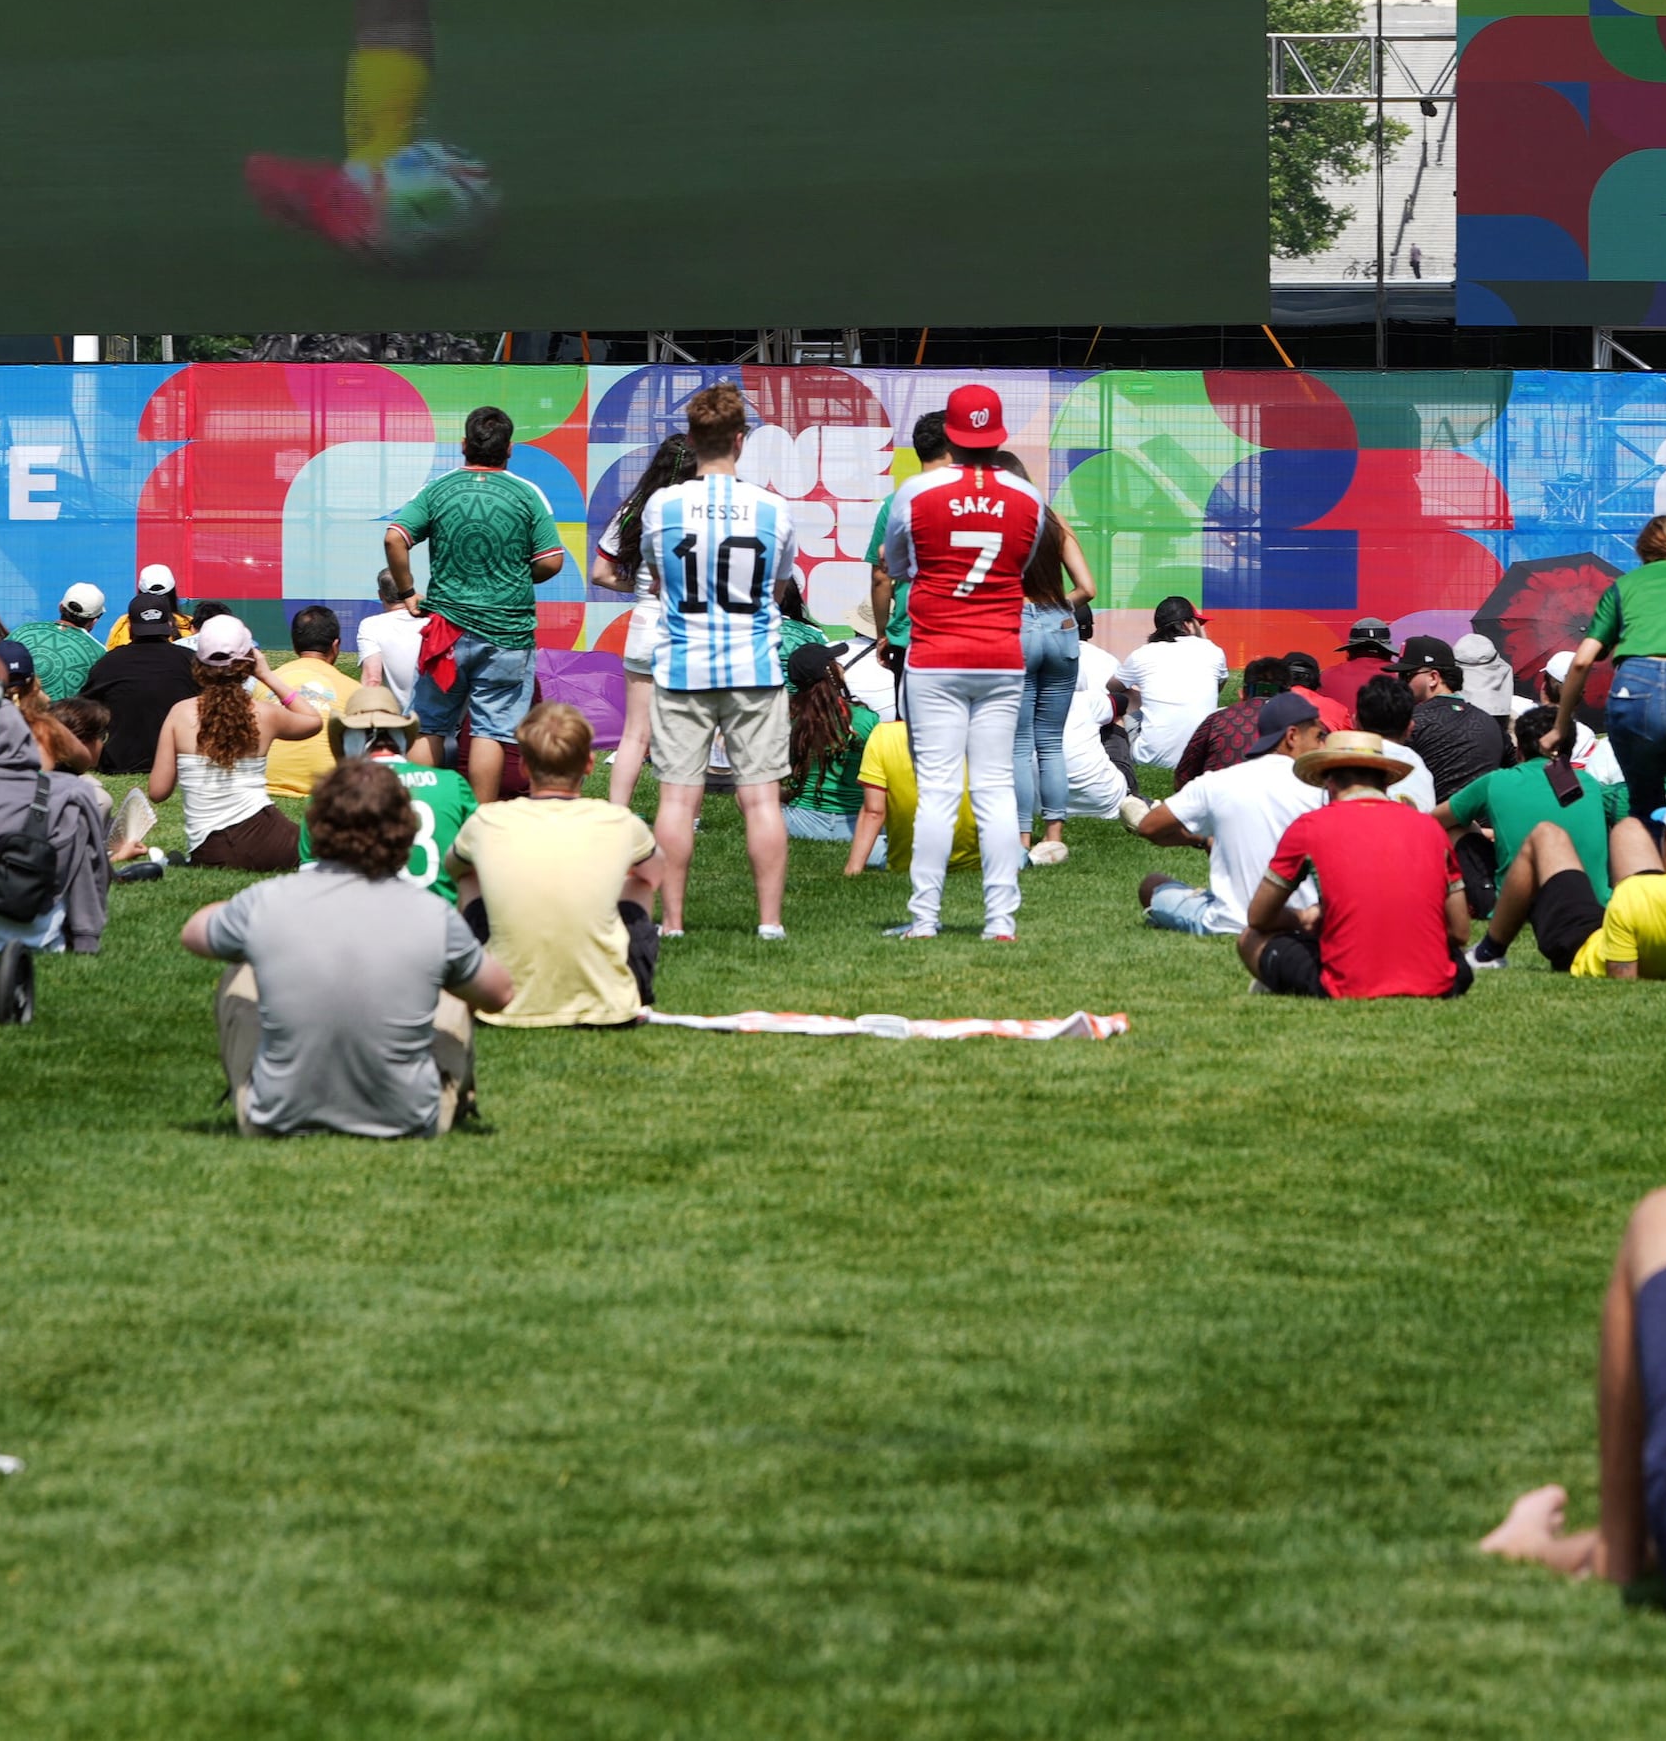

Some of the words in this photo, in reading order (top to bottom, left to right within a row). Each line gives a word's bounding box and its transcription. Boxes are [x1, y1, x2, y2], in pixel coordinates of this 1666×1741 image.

[691, 504, 749, 521] MESSI
[949, 495, 1005, 518] SAKA
[673, 533, 767, 614] 10
[950, 531, 1004, 597] 7
